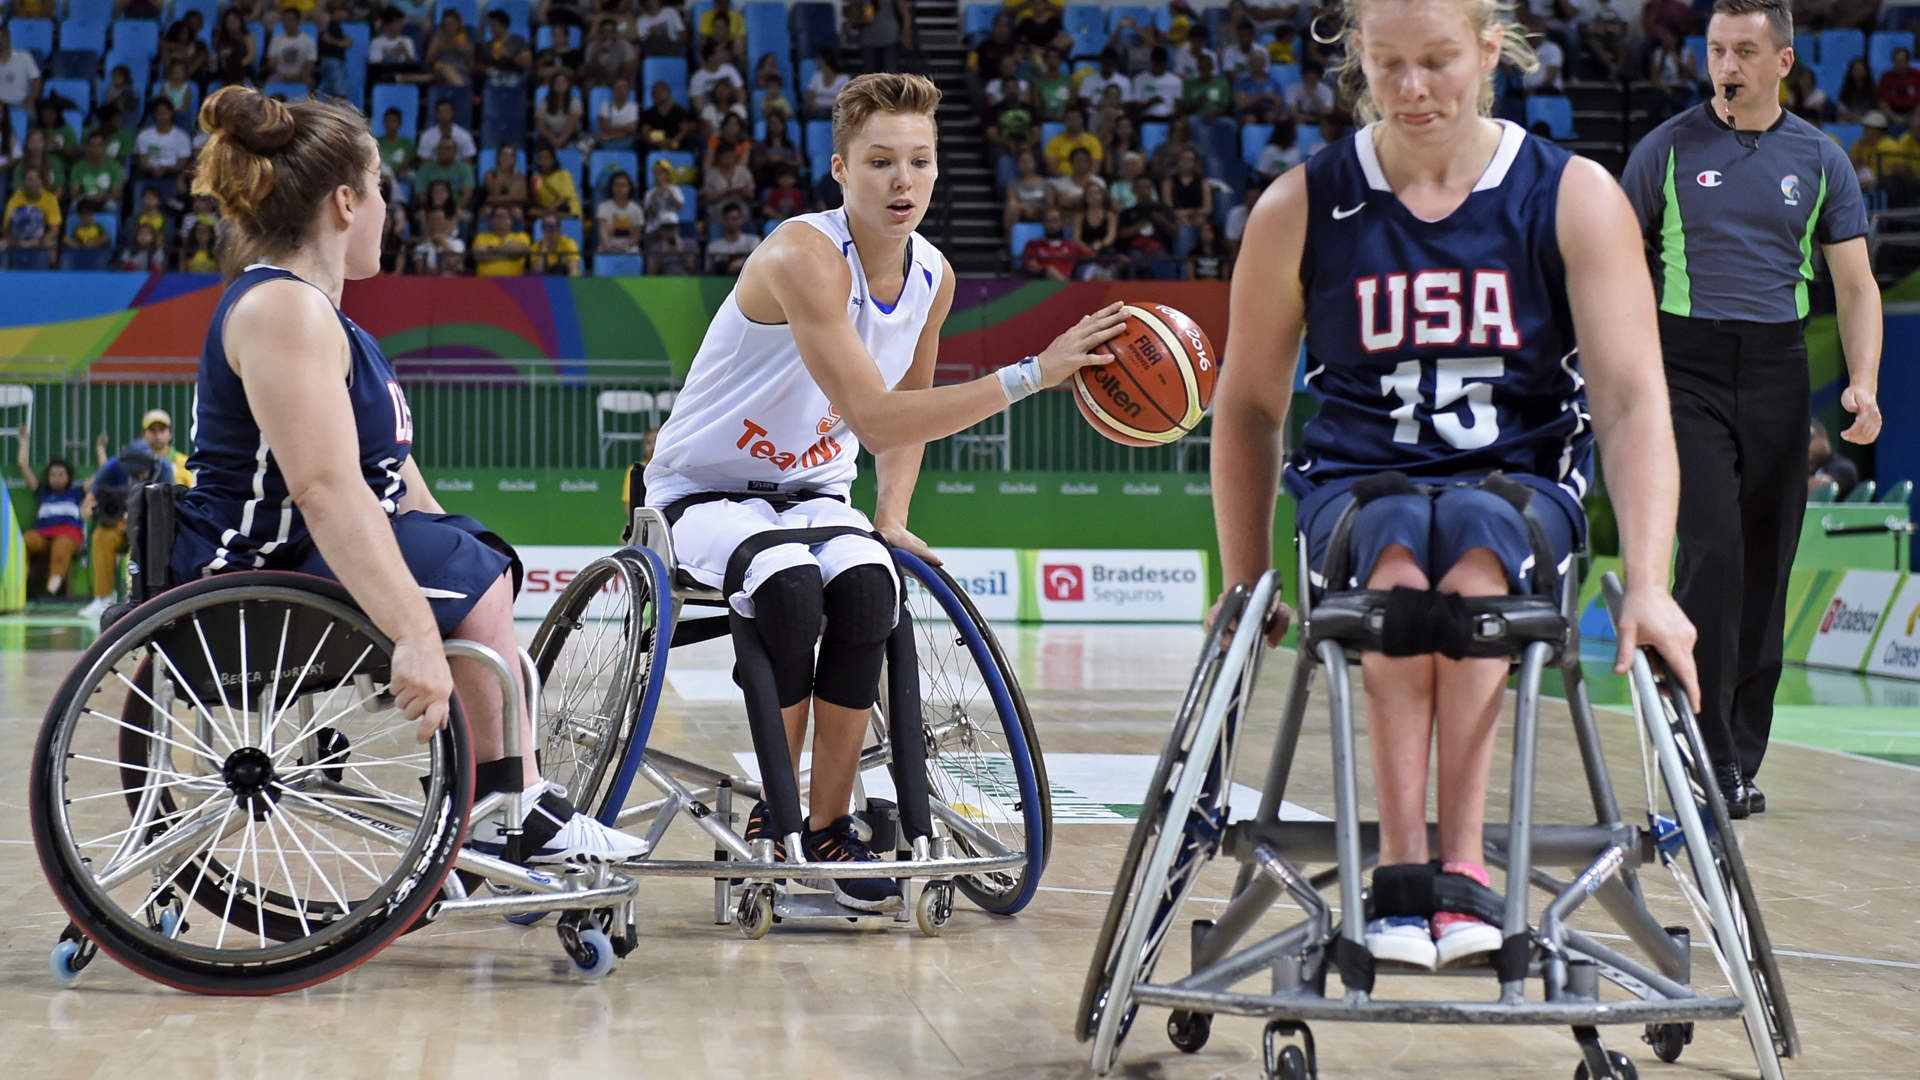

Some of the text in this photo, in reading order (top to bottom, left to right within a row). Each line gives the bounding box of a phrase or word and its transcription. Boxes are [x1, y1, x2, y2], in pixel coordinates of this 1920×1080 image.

[1355, 267, 1523, 355] USA
[1134, 335, 1163, 366] FIBA
[1186, 328, 1211, 372] 2016
[1380, 356, 1505, 450] 15
[1092, 565, 1197, 583] Bradesco
[1092, 586, 1165, 606] Seguros
[1832, 602, 1879, 633] Bradesco
[438, 816, 460, 864] KENDA
